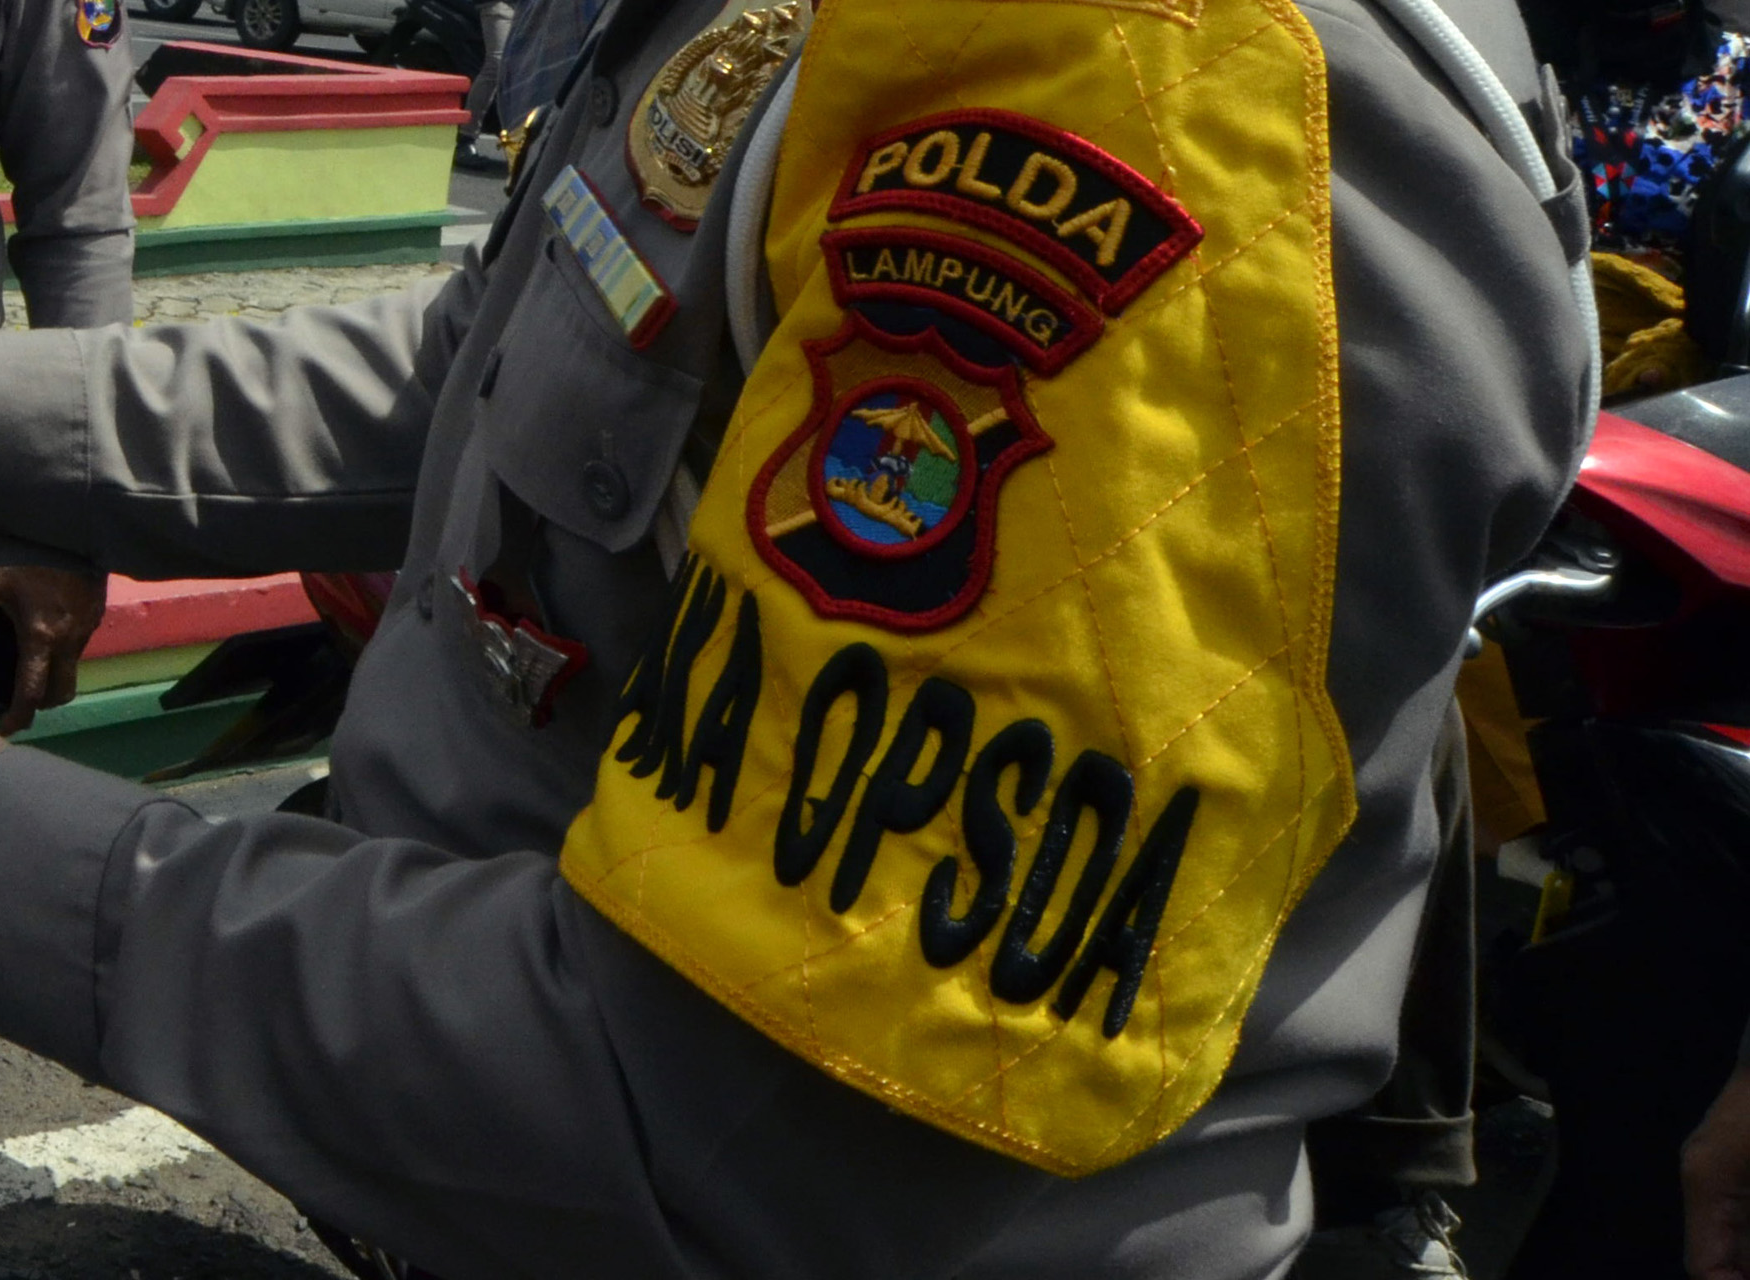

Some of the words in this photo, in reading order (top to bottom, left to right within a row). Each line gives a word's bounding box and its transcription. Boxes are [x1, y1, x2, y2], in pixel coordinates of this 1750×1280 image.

[855, 128, 1132, 270] POLDA
[847, 248, 1062, 351] LAMPUNG
[772, 640, 1201, 1042] OPSDA
